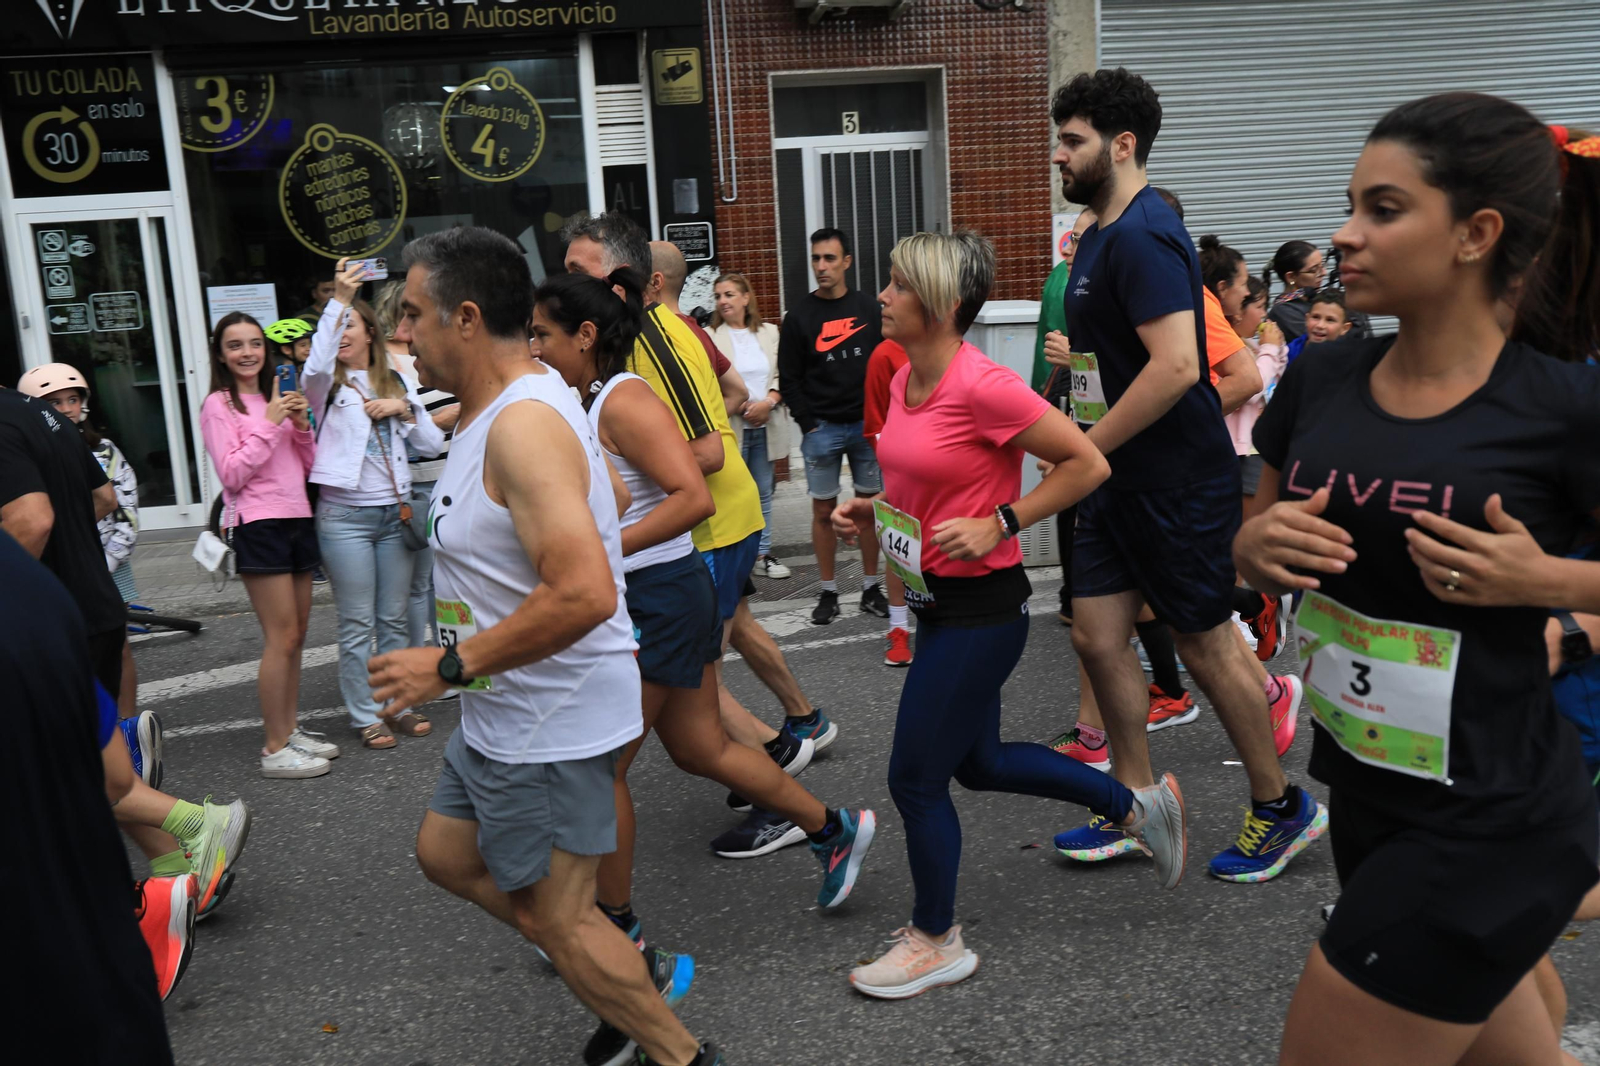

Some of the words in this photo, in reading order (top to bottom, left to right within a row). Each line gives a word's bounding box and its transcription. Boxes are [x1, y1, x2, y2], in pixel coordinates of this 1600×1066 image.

[308, 7, 449, 34] Lavandería
[463, 2, 616, 28] Autoservicio
[9, 70, 42, 96] TU
[47, 67, 143, 94] COLADA
[87, 104, 109, 120] en
[112, 97, 145, 118] solo
[195, 76, 232, 133] 3
[460, 98, 500, 120] Lavado
[501, 107, 515, 122] 13
[515, 109, 530, 130] kg
[845, 114, 856, 134] 3
[43, 132, 80, 165] 30
[101, 148, 150, 163] minutos
[471, 124, 495, 168] 4
[306, 152, 354, 177] mantas
[304, 167, 370, 196] edredones
[315, 186, 370, 212] nórdicos
[325, 204, 374, 228] colchas
[329, 220, 381, 246] cortinas
[826, 347, 862, 362] AIR
[1287, 460, 1454, 518] LIVE!
[888, 532, 910, 559] 144
[438, 628, 457, 648] 57
[1350, 660, 1371, 696] 3
